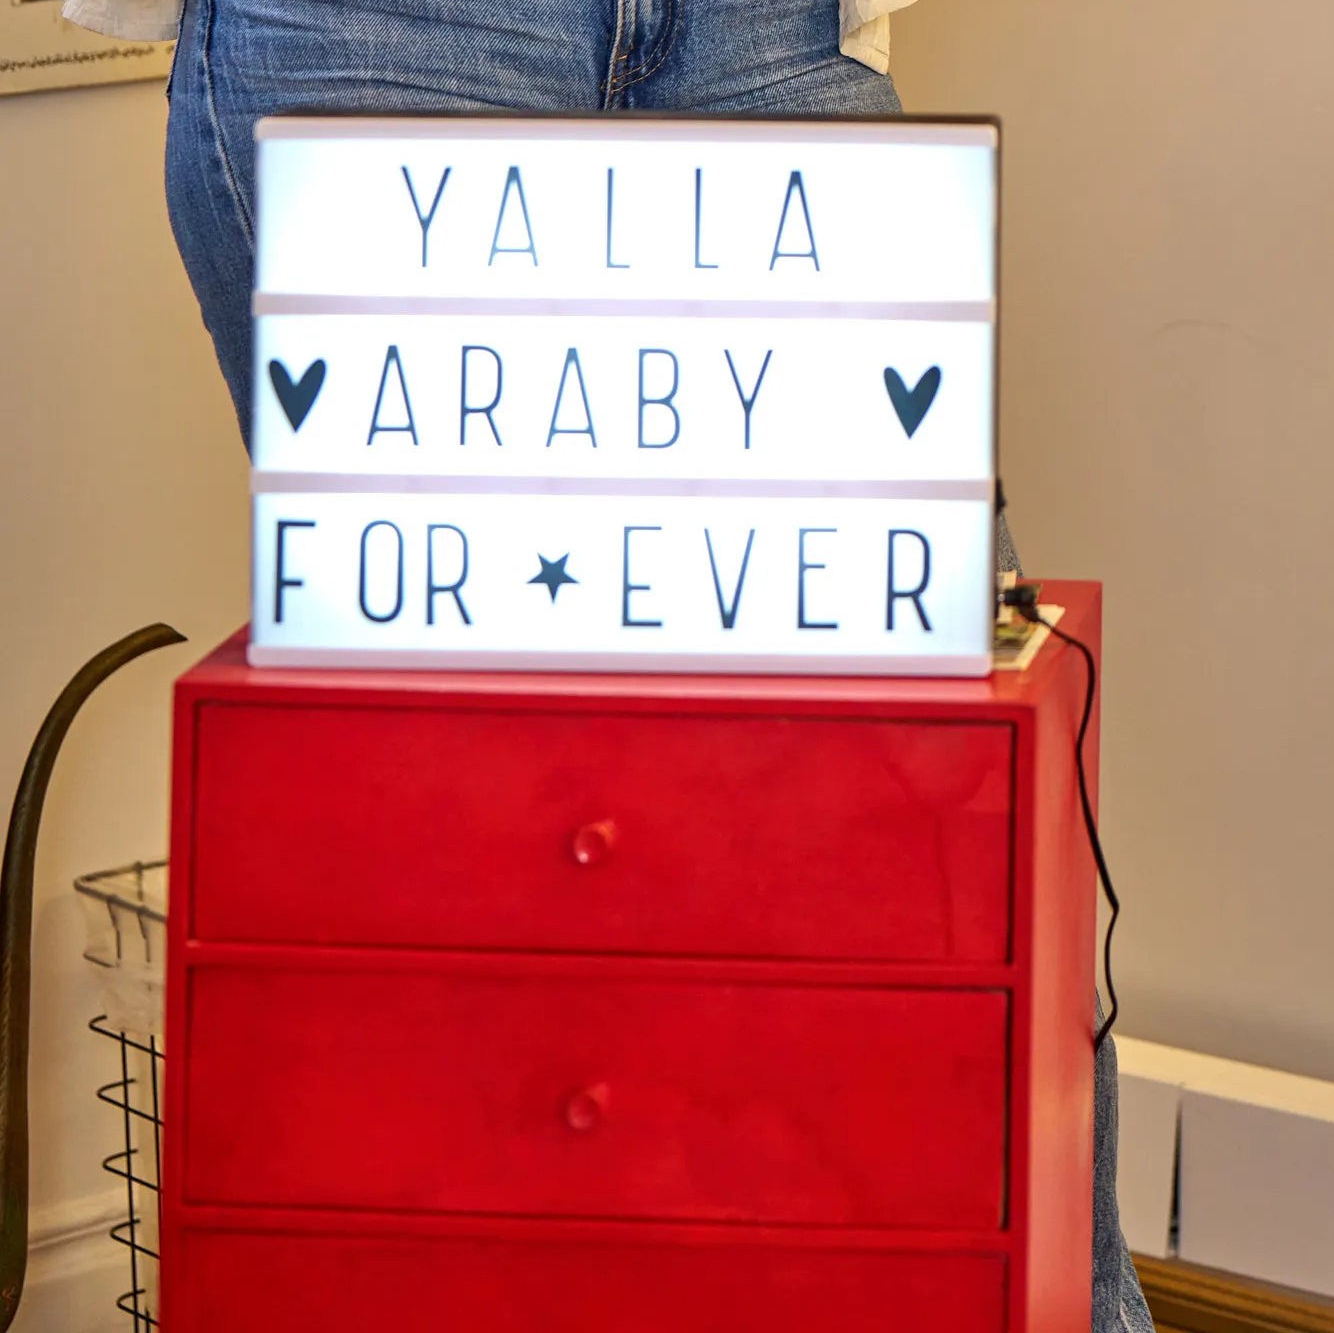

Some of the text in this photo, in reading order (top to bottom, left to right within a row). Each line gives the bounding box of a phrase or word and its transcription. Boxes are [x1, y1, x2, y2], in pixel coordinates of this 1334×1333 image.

[401, 165, 821, 272] YALLA
[366, 344, 774, 451] ARABY
[273, 519, 933, 633] FOR EVER
